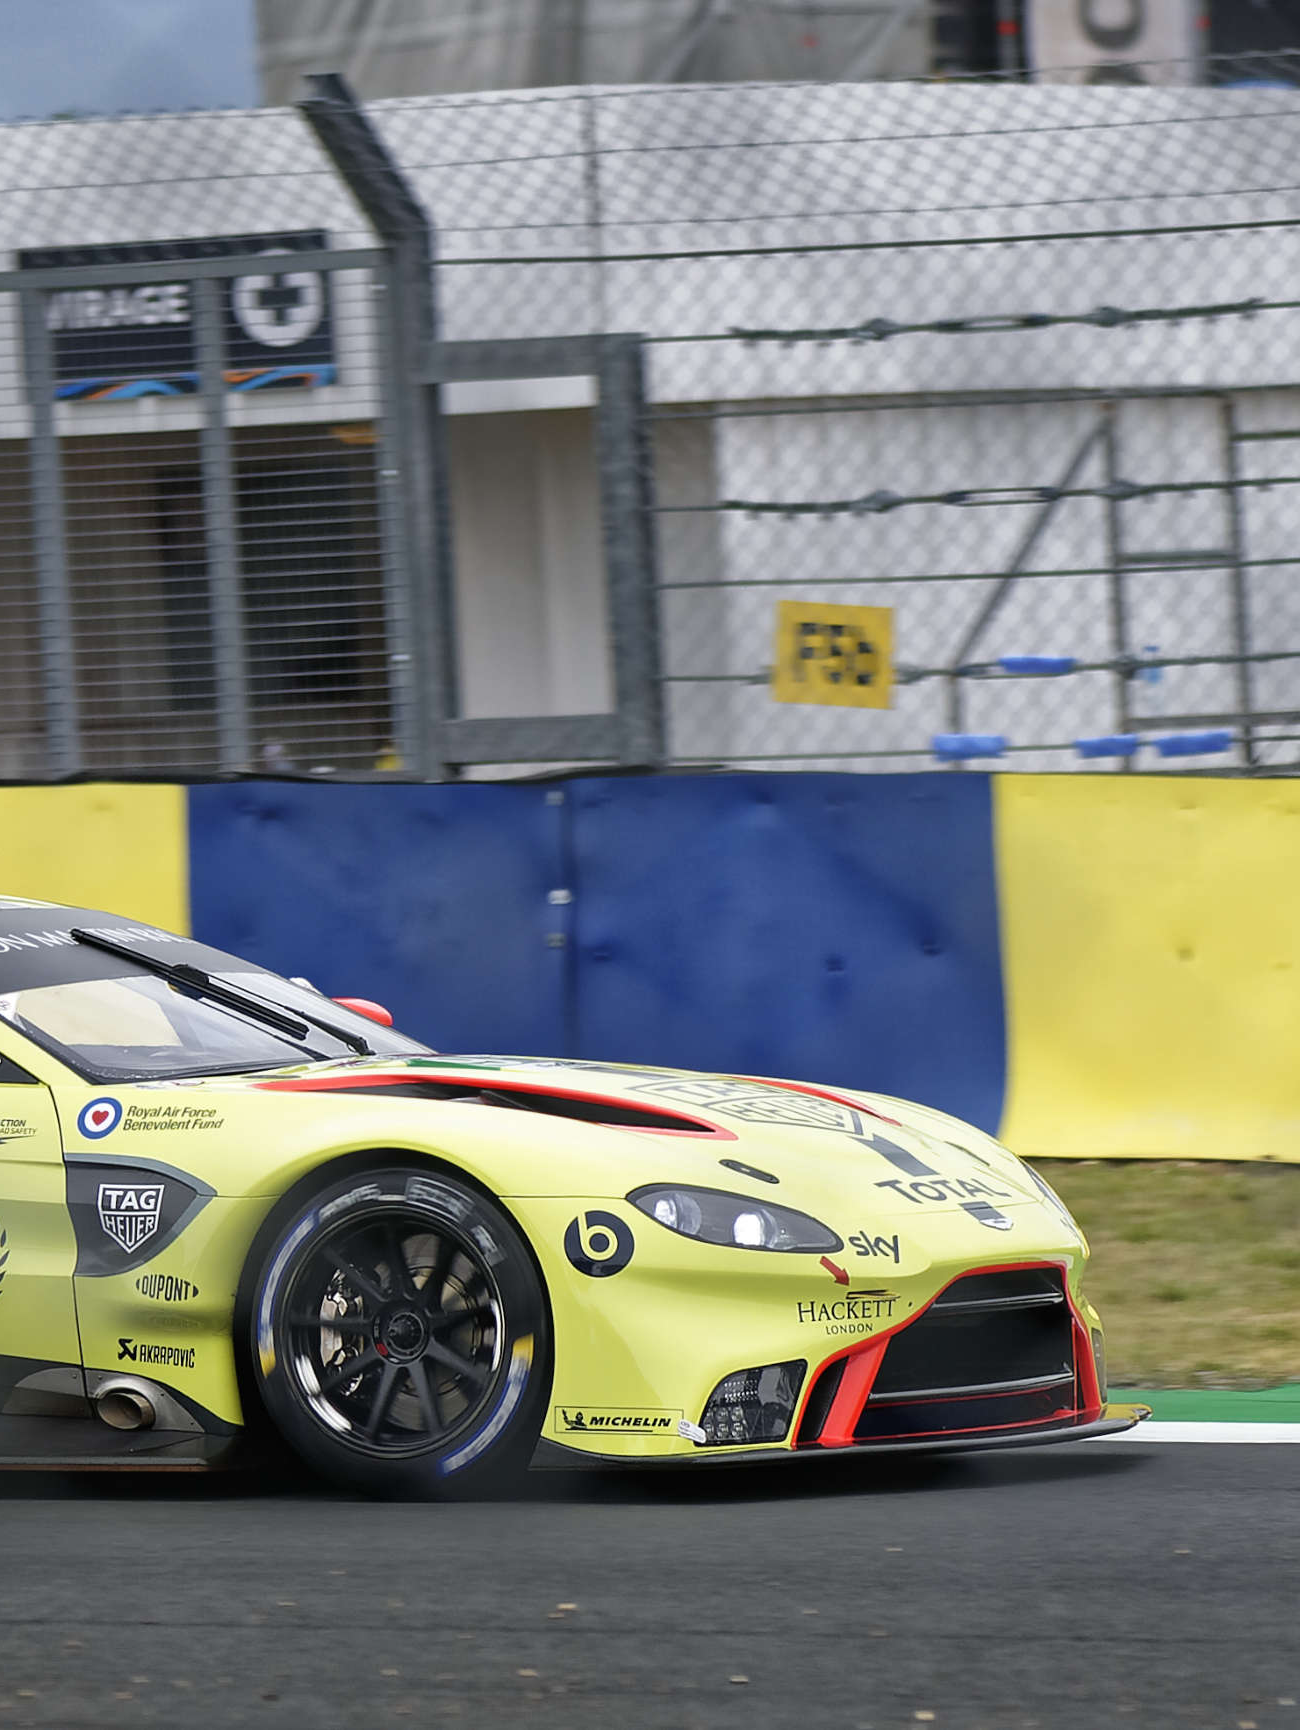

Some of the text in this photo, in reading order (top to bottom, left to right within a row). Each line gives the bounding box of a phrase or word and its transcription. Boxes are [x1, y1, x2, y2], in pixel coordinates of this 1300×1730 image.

[127, 1105, 218, 1120] Royal Air Force
[10, 1127, 37, 1135] SAFETY
[122, 1118, 225, 1132] Benevolent Fund
[104, 1189, 158, 1211] TAG
[874, 1177, 1013, 1205] TOTAL
[104, 1215, 156, 1248] HEUER
[848, 1230, 900, 1264] sky
[141, 1273, 192, 1302] DUPONT
[796, 1299, 898, 1323] HACKETT
[826, 1322, 874, 1336] LONDON
[140, 1344, 196, 1369] AKRAPOVIČ
[588, 1415, 672, 1428] MICHELIN
